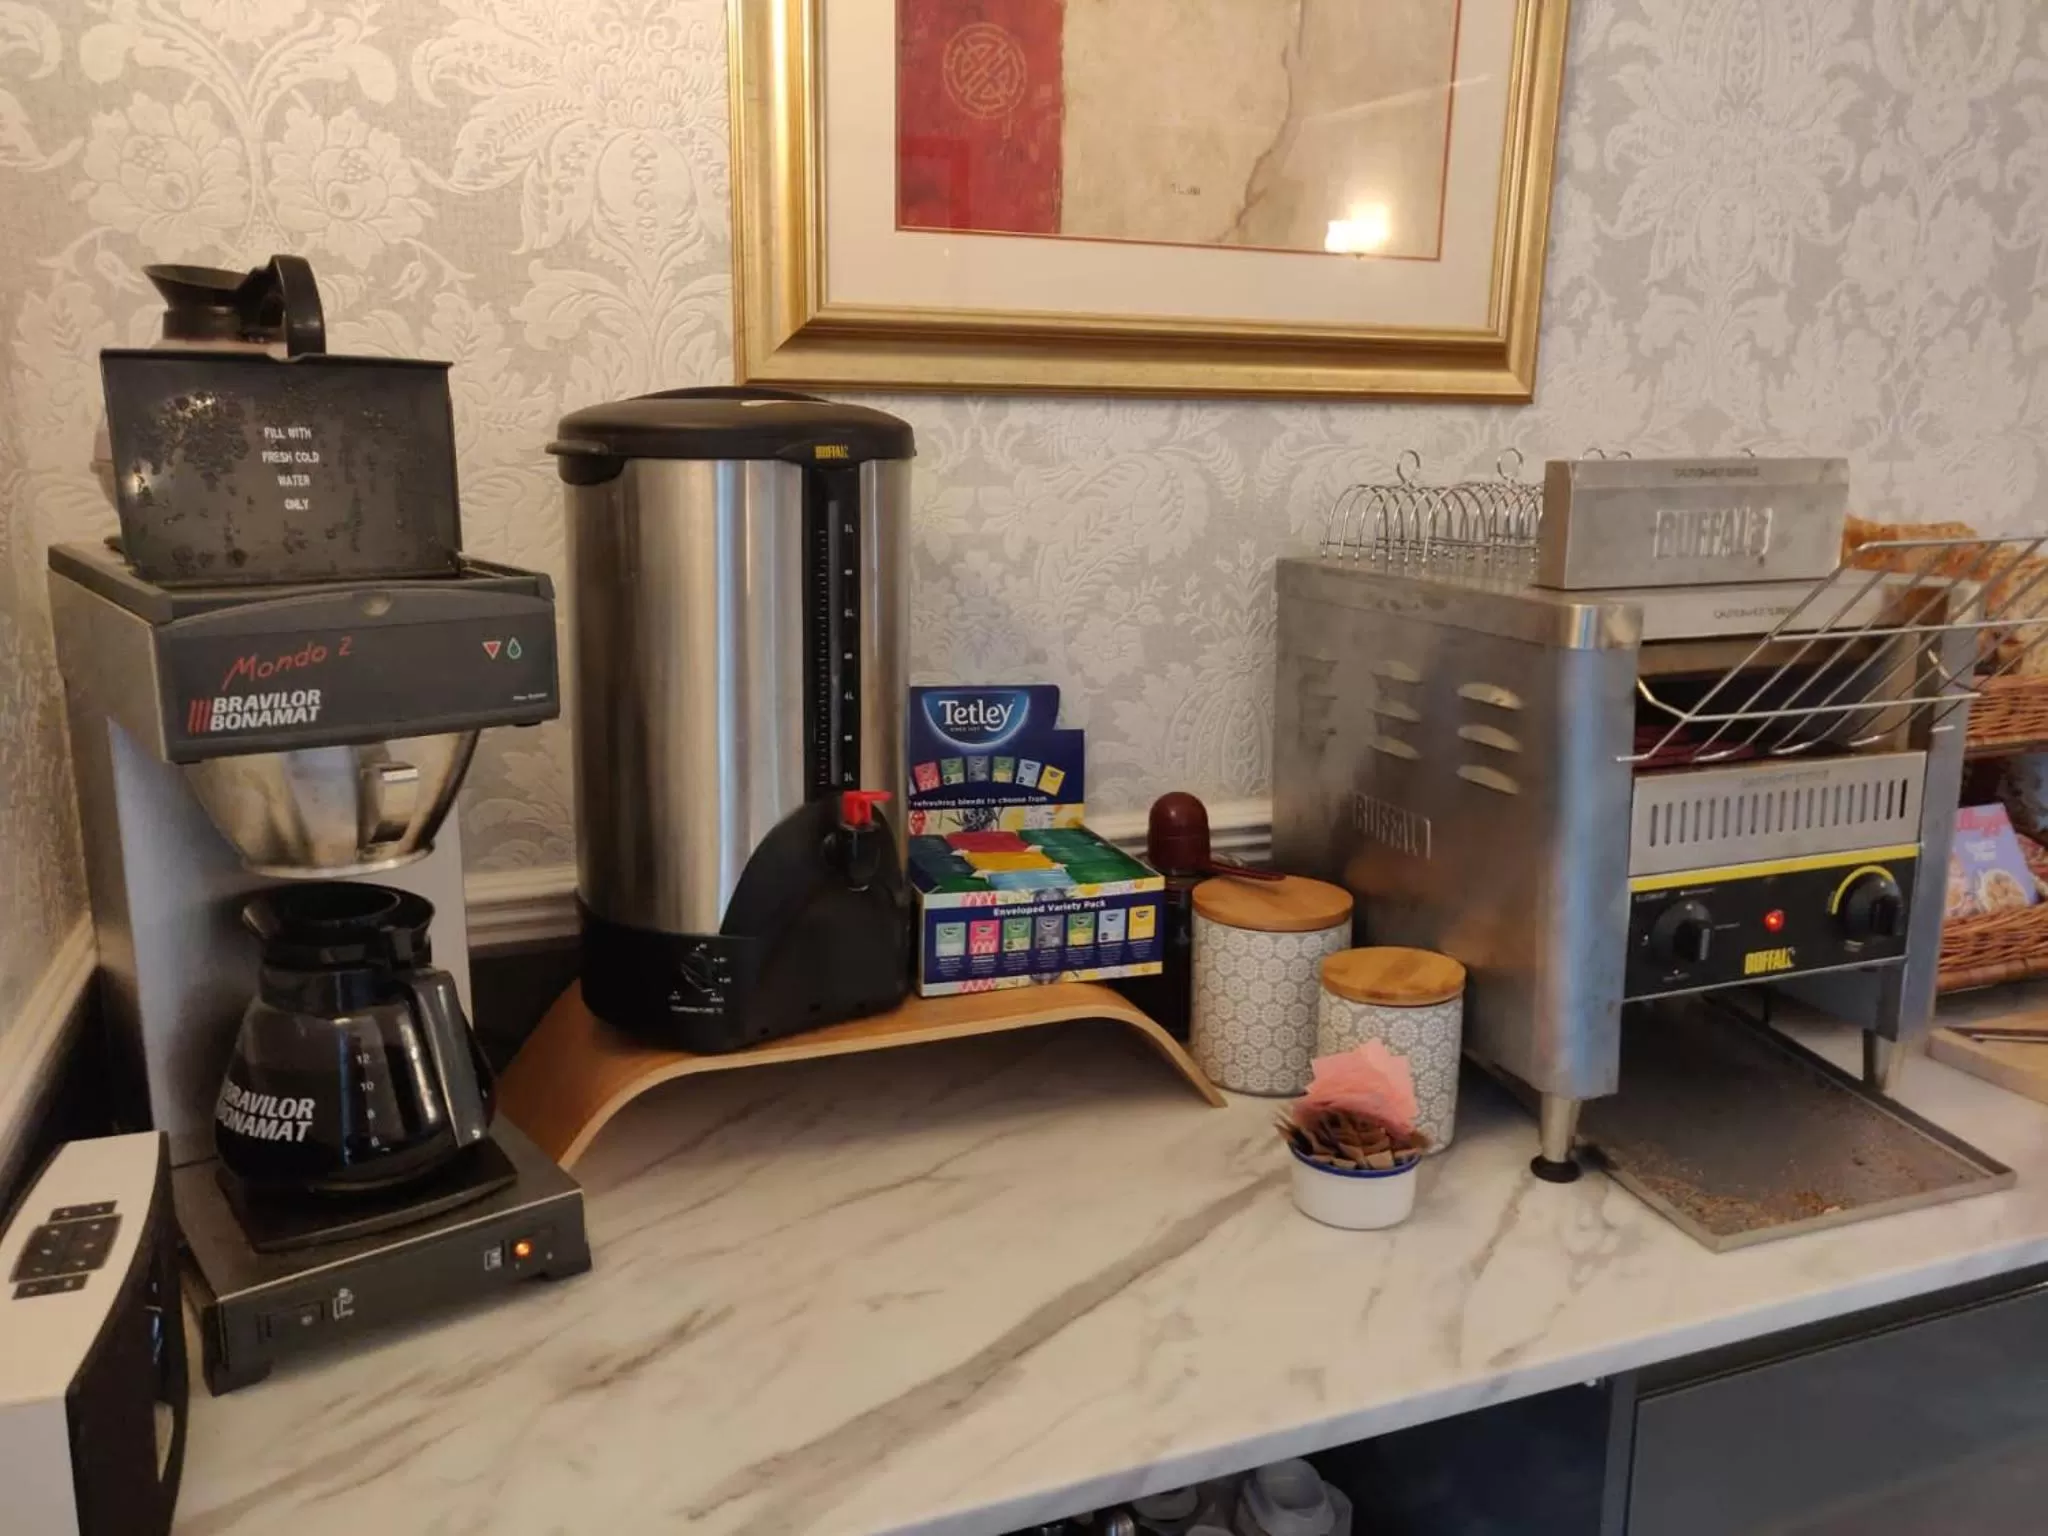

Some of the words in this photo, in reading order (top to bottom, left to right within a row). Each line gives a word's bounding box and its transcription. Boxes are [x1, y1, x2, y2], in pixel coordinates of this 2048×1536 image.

[264, 427, 286, 439] FILL
[288, 427, 312, 439] WITH
[262, 451, 293, 463] FRESH
[295, 450, 320, 463] COLD
[277, 474, 311, 487] WATER
[284, 498, 309, 510] ONLY
[221, 640, 328, 691] Mondo
[338, 635, 353, 657] 2
[212, 689, 321, 714] BRAVILOR
[210, 706, 321, 732] BONAMAT
[937, 699, 1015, 732] Tetley
[993, 904, 1045, 917] Enveloped
[1047, 902, 1081, 913] Variety
[1083, 899, 1106, 909] Pack
